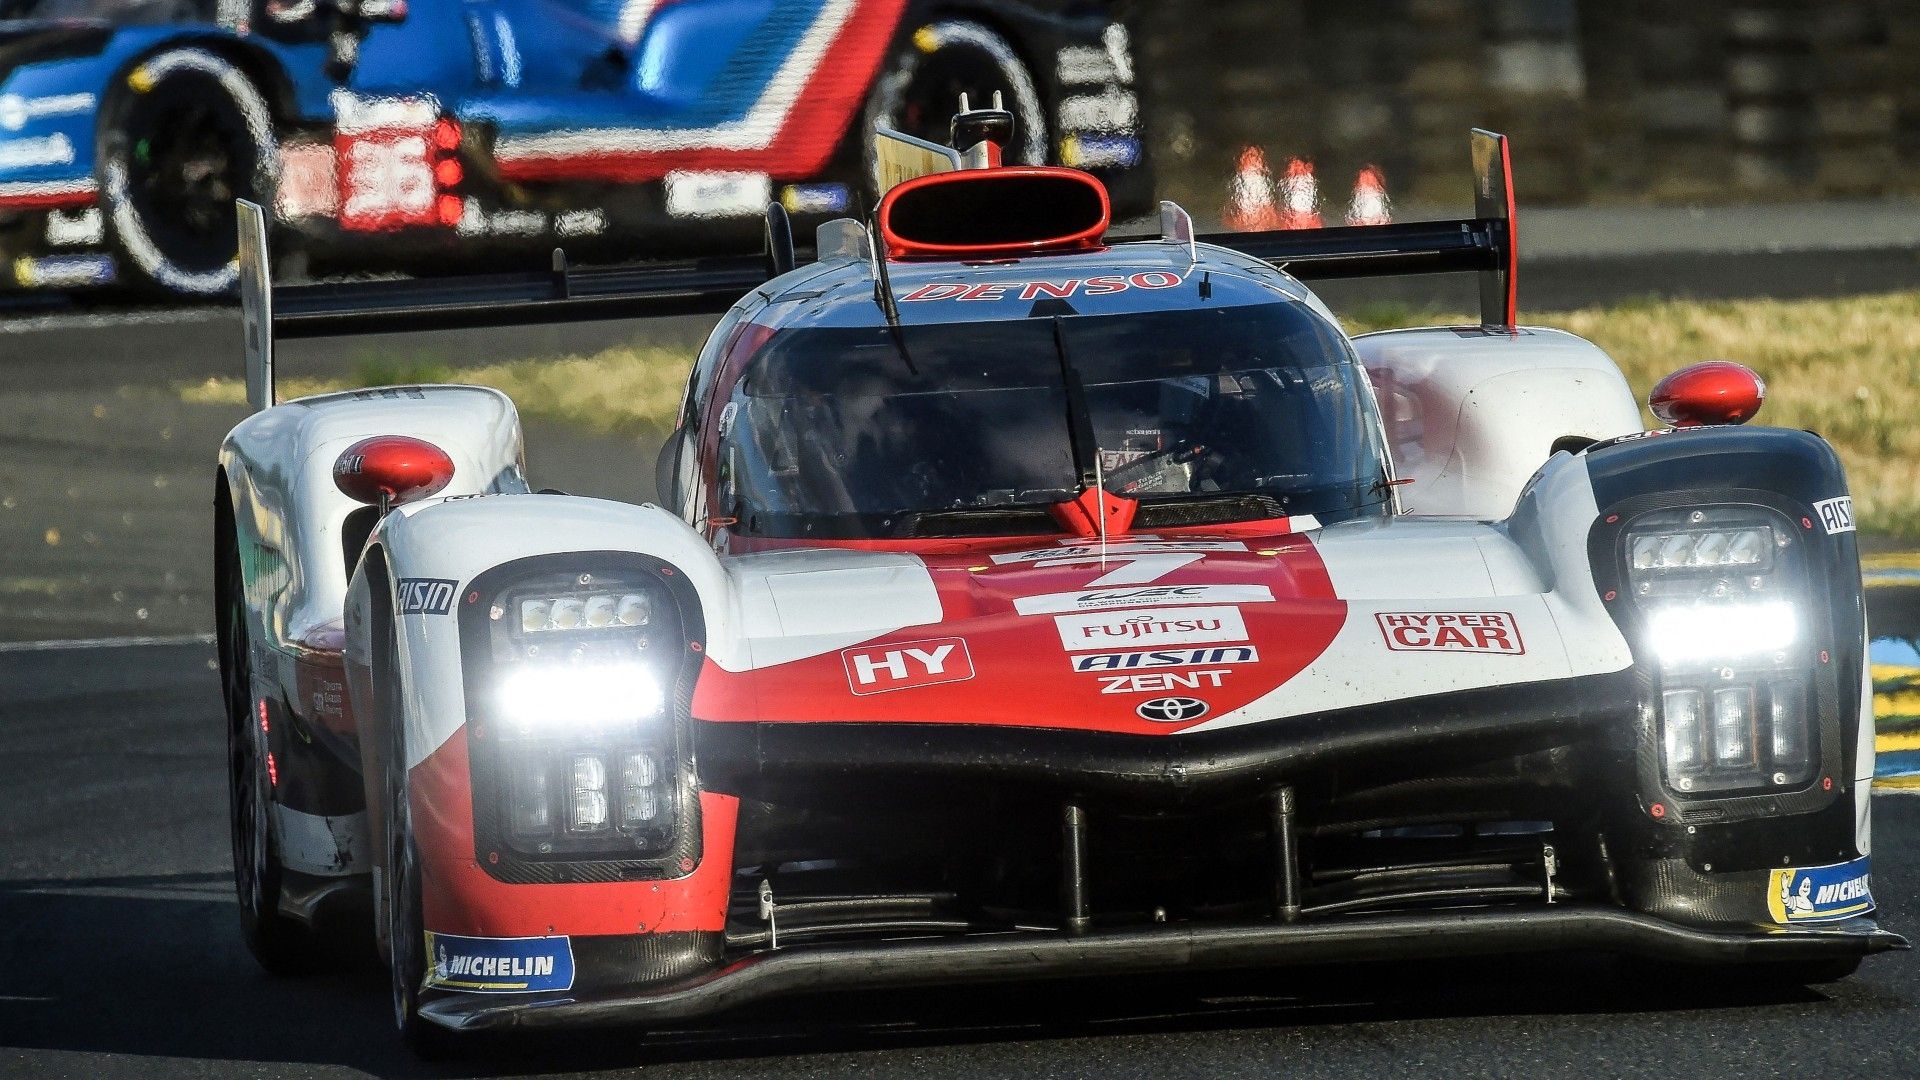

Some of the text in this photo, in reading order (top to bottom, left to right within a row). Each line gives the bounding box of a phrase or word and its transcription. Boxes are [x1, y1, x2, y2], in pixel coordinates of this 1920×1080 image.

[898, 271, 1183, 302] DENSO
[1033, 552, 1207, 588] 7
[397, 582, 453, 610] AISIN
[1082, 617, 1222, 639] FUJITSU
[1386, 615, 1505, 627] HYPER
[1393, 626, 1513, 649] CAR
[853, 644, 955, 685] HY
[1078, 647, 1252, 671] AISIN
[1097, 669, 1232, 694] ZENT
[450, 955, 554, 977] MICHELIN
